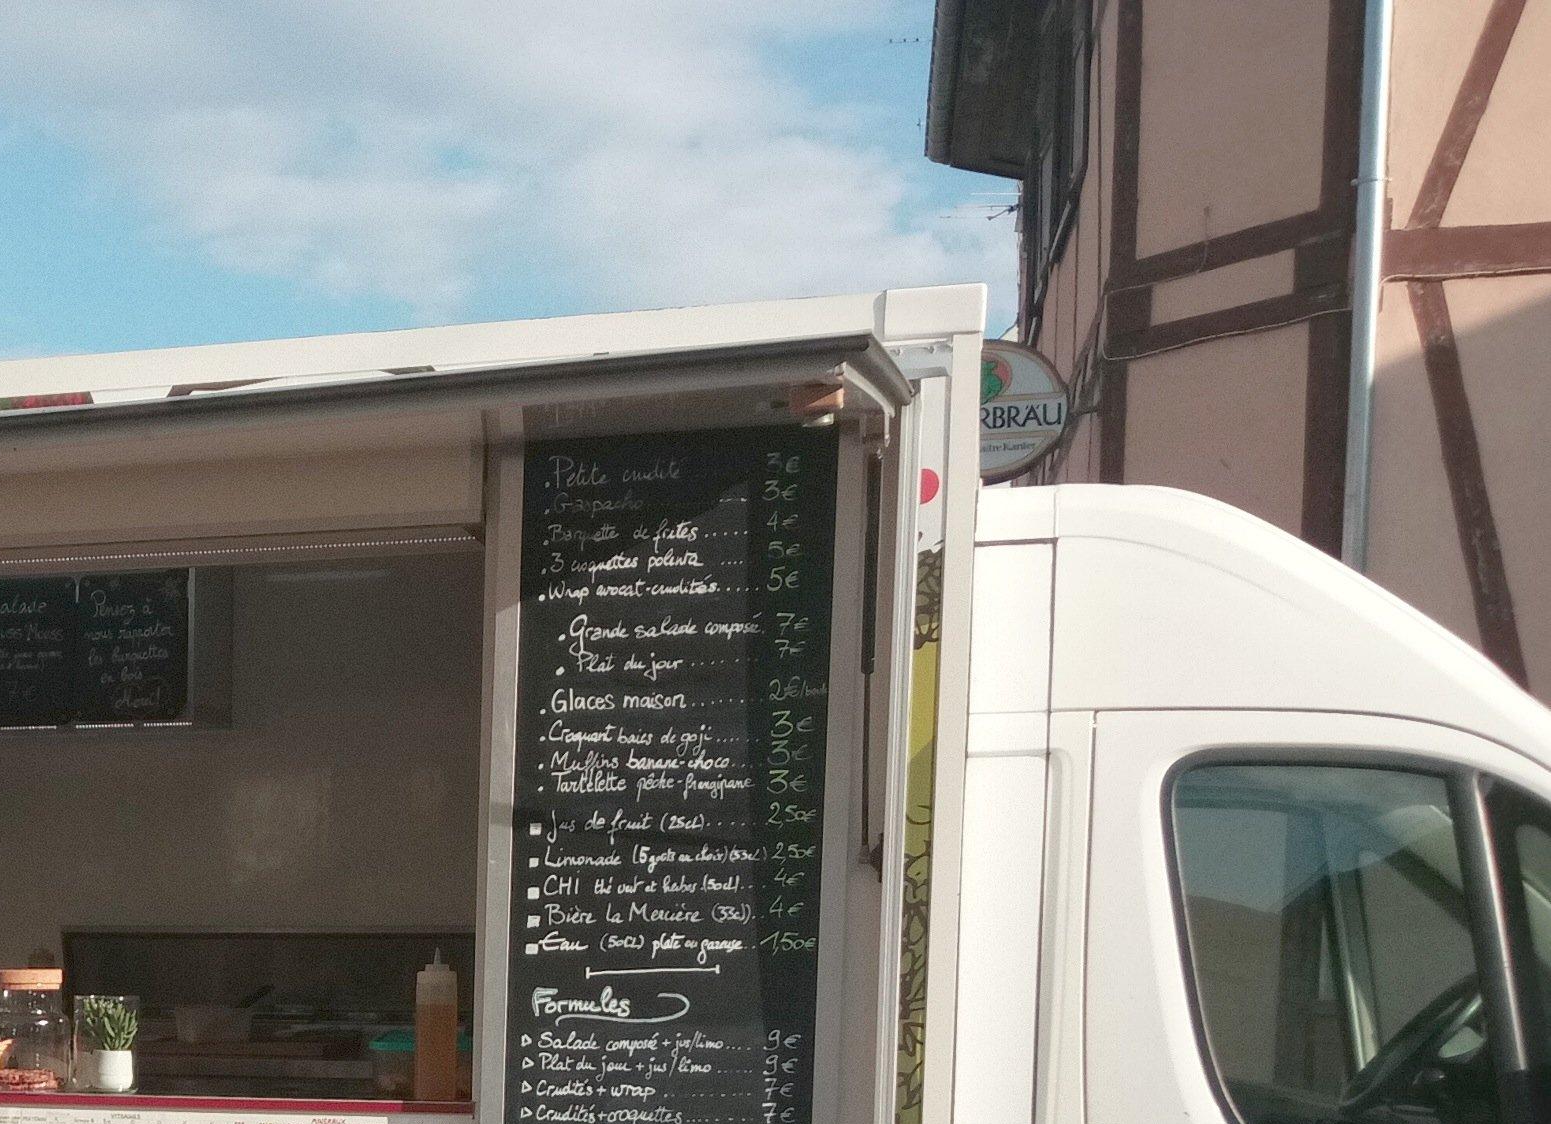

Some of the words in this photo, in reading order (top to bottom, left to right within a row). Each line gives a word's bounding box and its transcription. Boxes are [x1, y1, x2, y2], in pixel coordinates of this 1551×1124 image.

[548, 456, 610, 488] Petite
[762, 479, 799, 501] 3€
[633, 525, 650, 540] de
[653, 518, 699, 554] frites
[767, 511, 799, 533] 4€
[550, 553, 565, 573] 3
[549, 581, 590, 605] Wrap
[766, 566, 800, 592] 5€
[569, 614, 629, 656] Grande
[634, 615, 698, 639] salade
[776, 612, 809, 635] 7€
[576, 650, 615, 673] Plat
[624, 653, 646, 671] du
[644, 652, 684, 681] jour
[551, 688, 616, 713] Glaces
[622, 692, 687, 709] maison
[549, 719, 617, 752] Croquant
[617, 727, 654, 746] baies
[660, 727, 677, 744] de
[676, 724, 713, 757] goji
[551, 750, 619, 776] Muffins
[551, 770, 627, 794] Tartelette
[766, 769, 808, 795] 3€
[548, 810, 576, 843] Jus
[584, 810, 606, 831] de
[607, 808, 653, 845] fruit
[767, 802, 818, 829] 2,50€
[544, 846, 622, 868] Limonade
[594, 876, 614, 895] thé
[617, 875, 645, 894] vert
[644, 880, 657, 893] et
[663, 875, 698, 894] herbes
[544, 904, 598, 926] Bière
[538, 931, 590, 951] Eau
[651, 932, 686, 960] plate
[531, 985, 632, 1018] Formules
[537, 1031, 600, 1050] Salade
[538, 1052, 575, 1071] Plat
[576, 1053, 597, 1070] du
[595, 1055, 632, 1081] jour
[536, 1078, 593, 1097] Crudités
[610, 1084, 657, 1102] wrap
